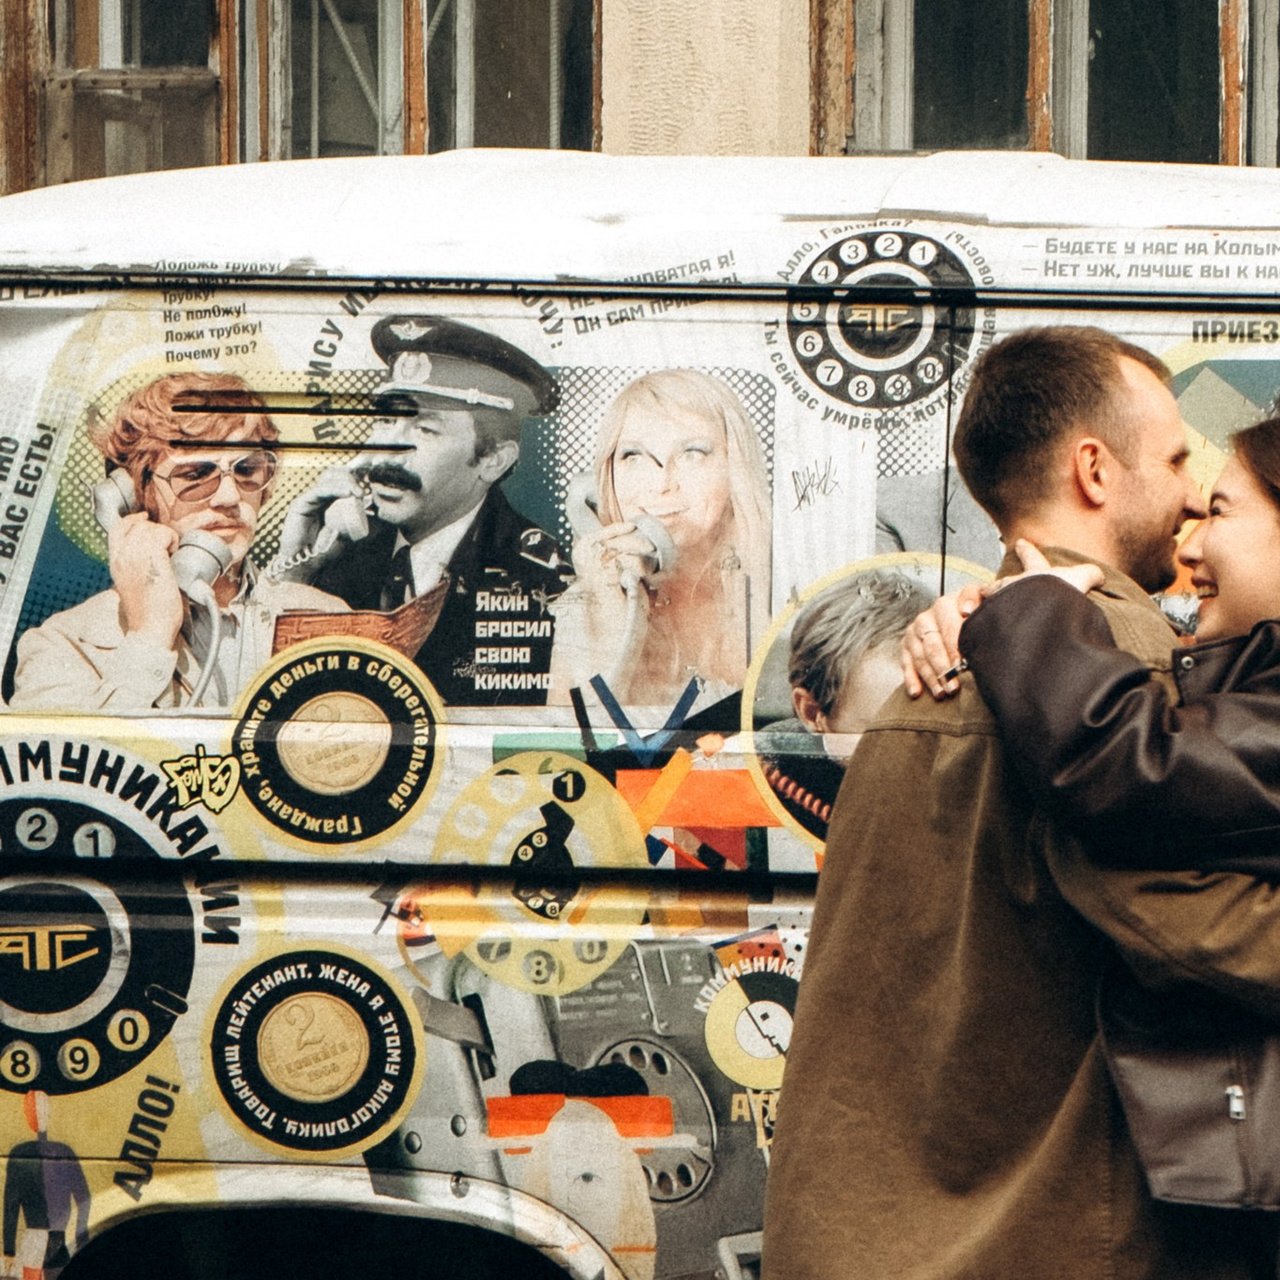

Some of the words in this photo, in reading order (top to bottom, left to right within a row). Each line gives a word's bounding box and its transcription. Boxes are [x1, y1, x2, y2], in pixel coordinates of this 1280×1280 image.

[882, 236, 896, 252] 2
[163, 309, 181, 324] Не
[165, 326, 205, 344] Ложи
[208, 320, 263, 341] трубку!
[165, 344, 221, 364] Почему
[225, 341, 258, 357] это?
[770, 351, 820, 410] сейчас
[13, 422, 58, 499] ЕСТЬ!
[348, 655, 360, 670] в
[269, 654, 340, 701] деньги
[239, 696, 273, 779] храните
[561, 772, 575, 799] 1
[258, 778, 364, 837] Граждане,
[27, 814, 47, 842] 2
[86, 828, 99, 858] 1
[119, 1017, 139, 1045] 0
[69, 1046, 90, 1075] 9
[224, 1043, 278, 1130] ТОВАРИЩ
[318, 963, 372, 998] ЖЕНА
[368, 994, 386, 1011] Я
[379, 1011, 402, 1076] ЭТОМУ
[10, 1049, 31, 1078] 8
[112, 1074, 181, 1203] АЛЛО!
